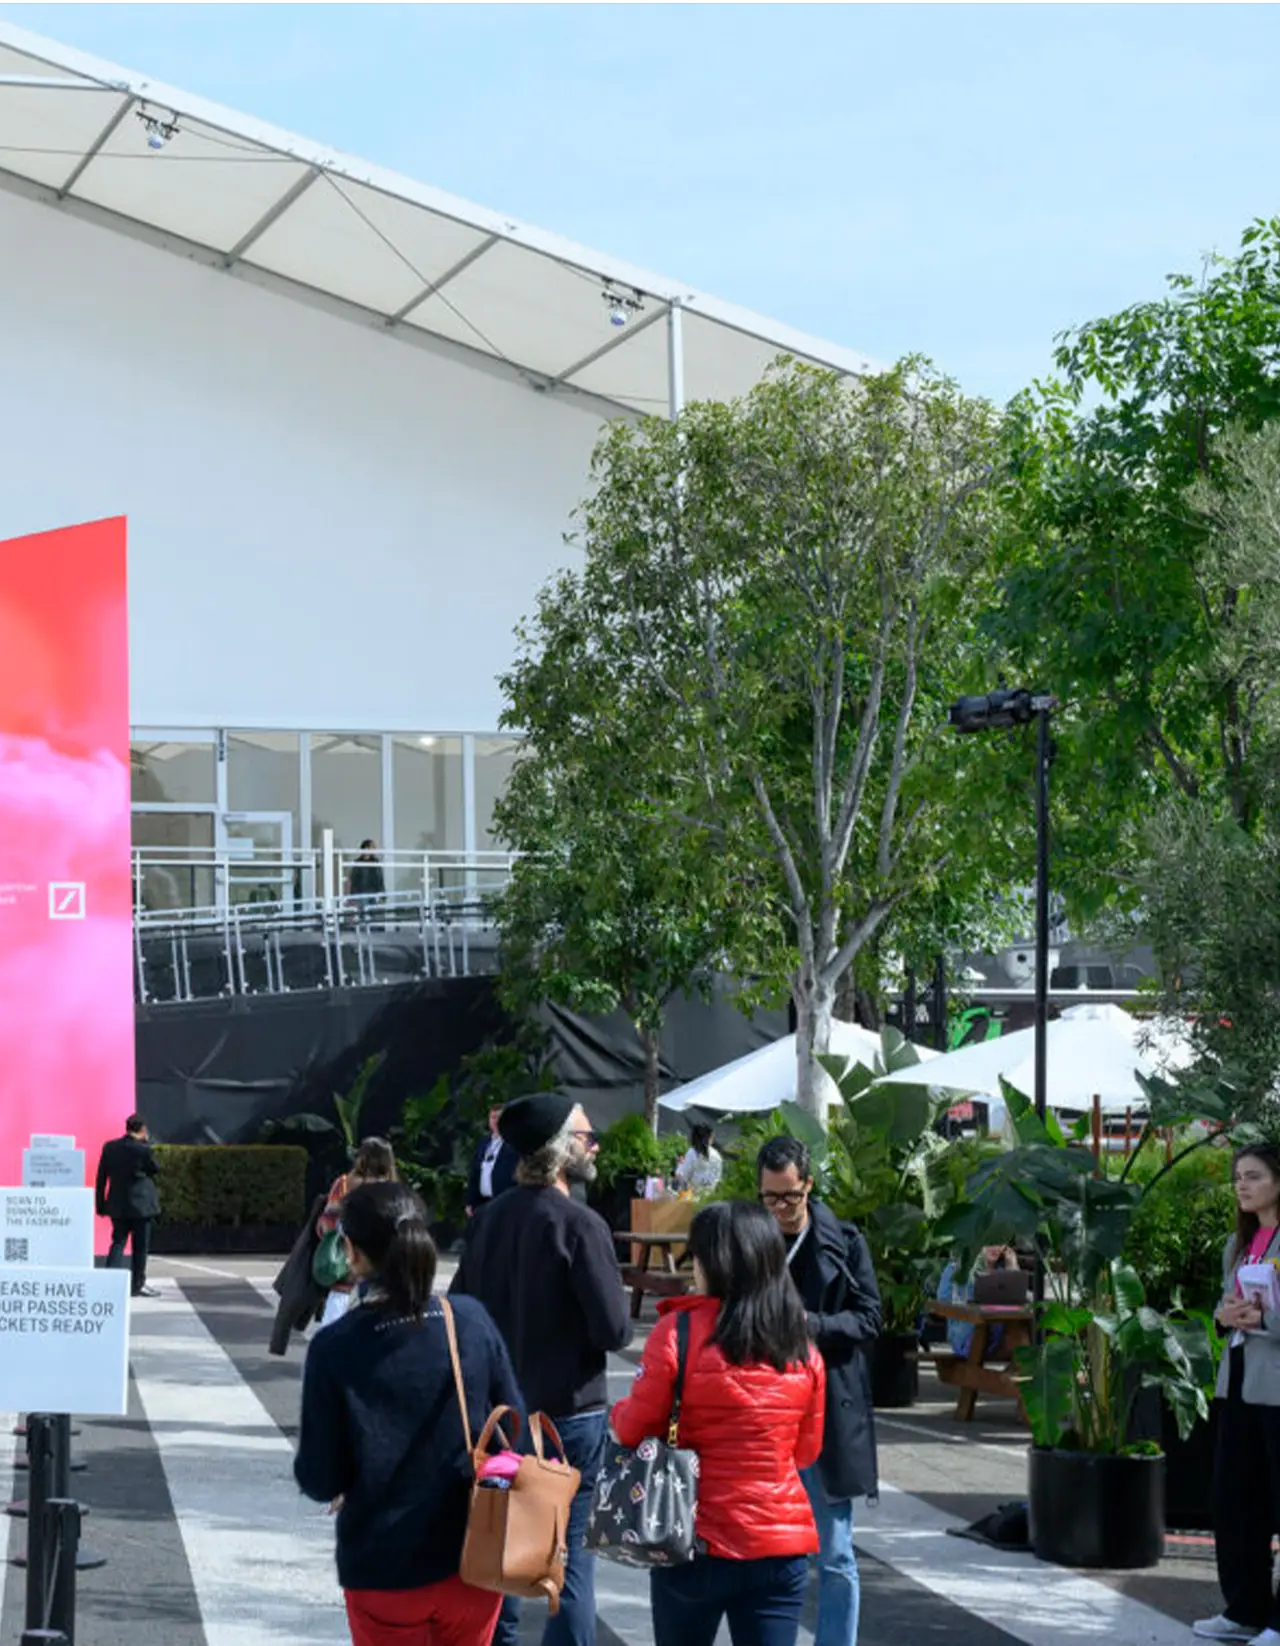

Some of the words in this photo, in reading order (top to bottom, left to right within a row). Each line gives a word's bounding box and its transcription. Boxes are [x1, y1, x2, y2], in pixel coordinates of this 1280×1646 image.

[45, 1282, 86, 1298] HAVE
[27, 1300, 88, 1317] PASSES
[91, 1301, 115, 1317] OR
[52, 1318, 105, 1334] READY
